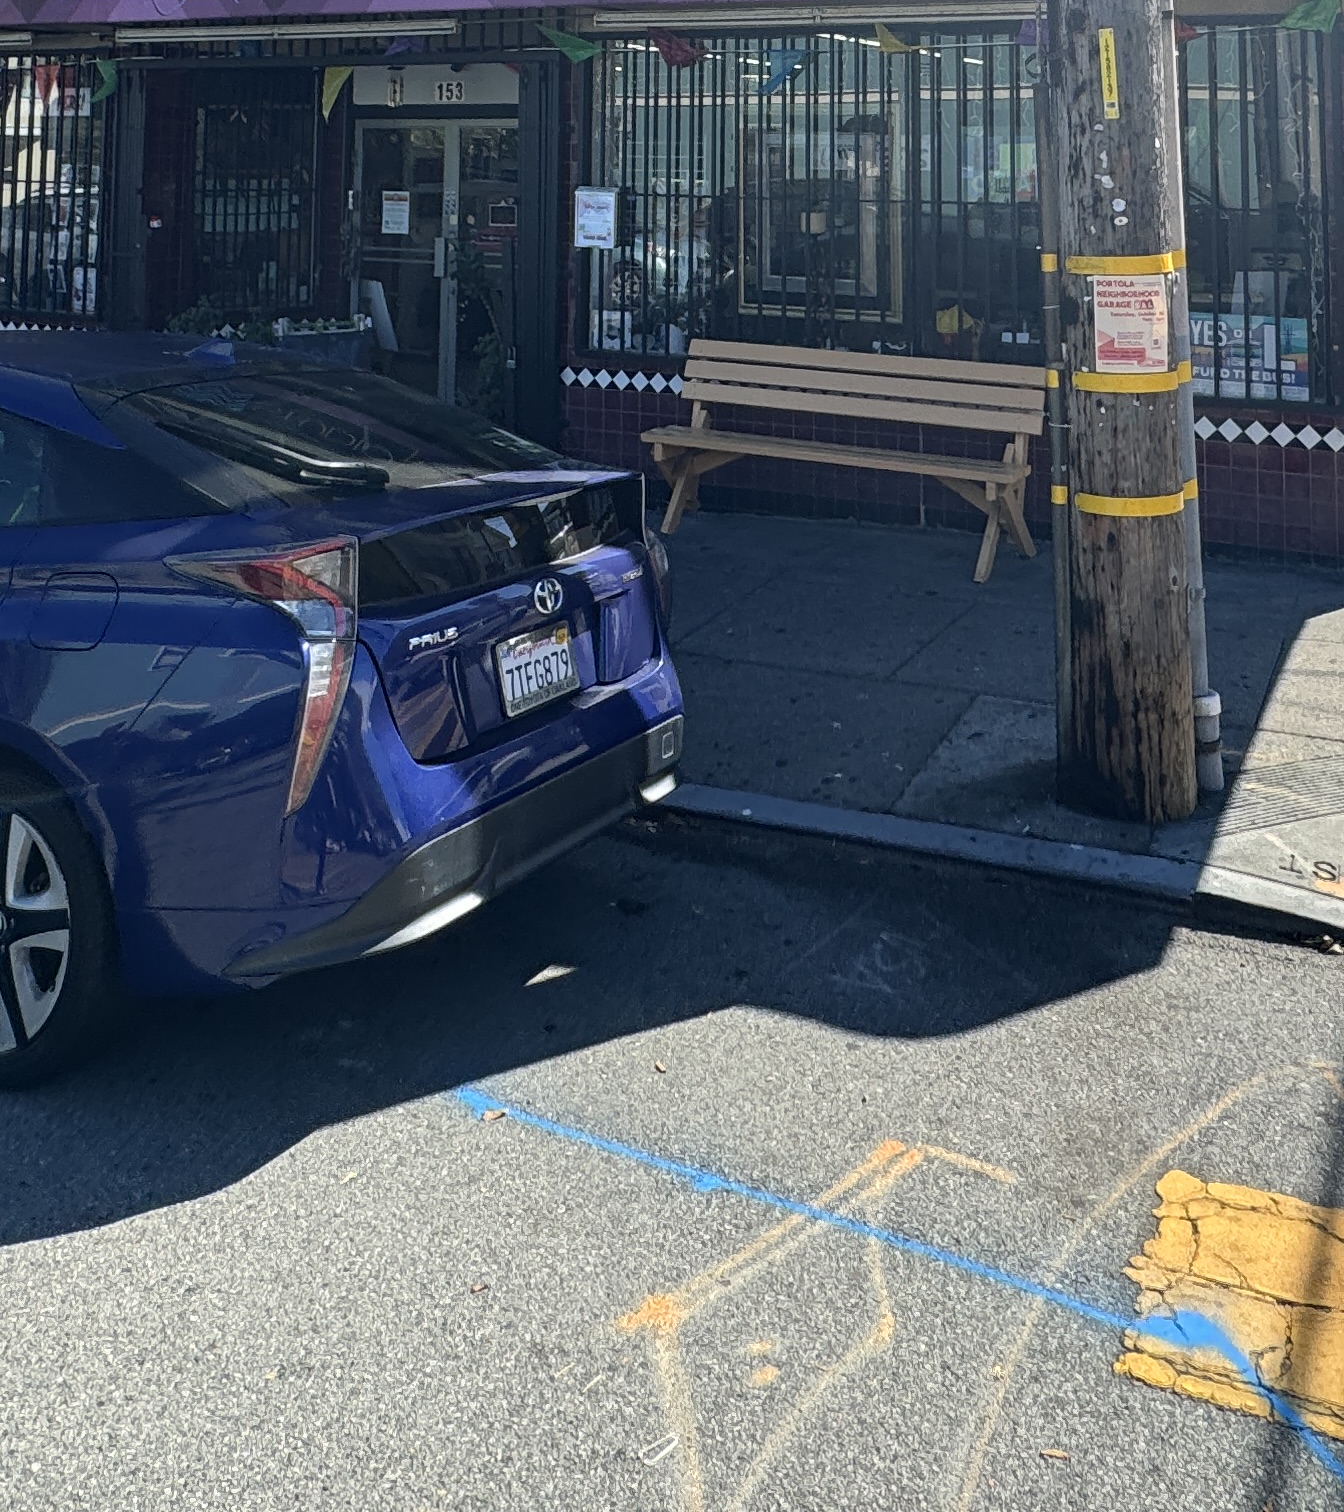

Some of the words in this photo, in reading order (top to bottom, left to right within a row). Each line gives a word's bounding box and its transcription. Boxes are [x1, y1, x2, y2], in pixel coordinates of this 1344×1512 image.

[438, 82, 463, 101] 153
[1097, 280, 1135, 288] PORTOLA
[1190, 319, 1227, 347] YES
[1193, 365, 1230, 380] FUD
[409, 626, 459, 651] PRIUS
[505, 648, 569, 702] 7TFG879
[1279, 854, 1338, 883] ST
